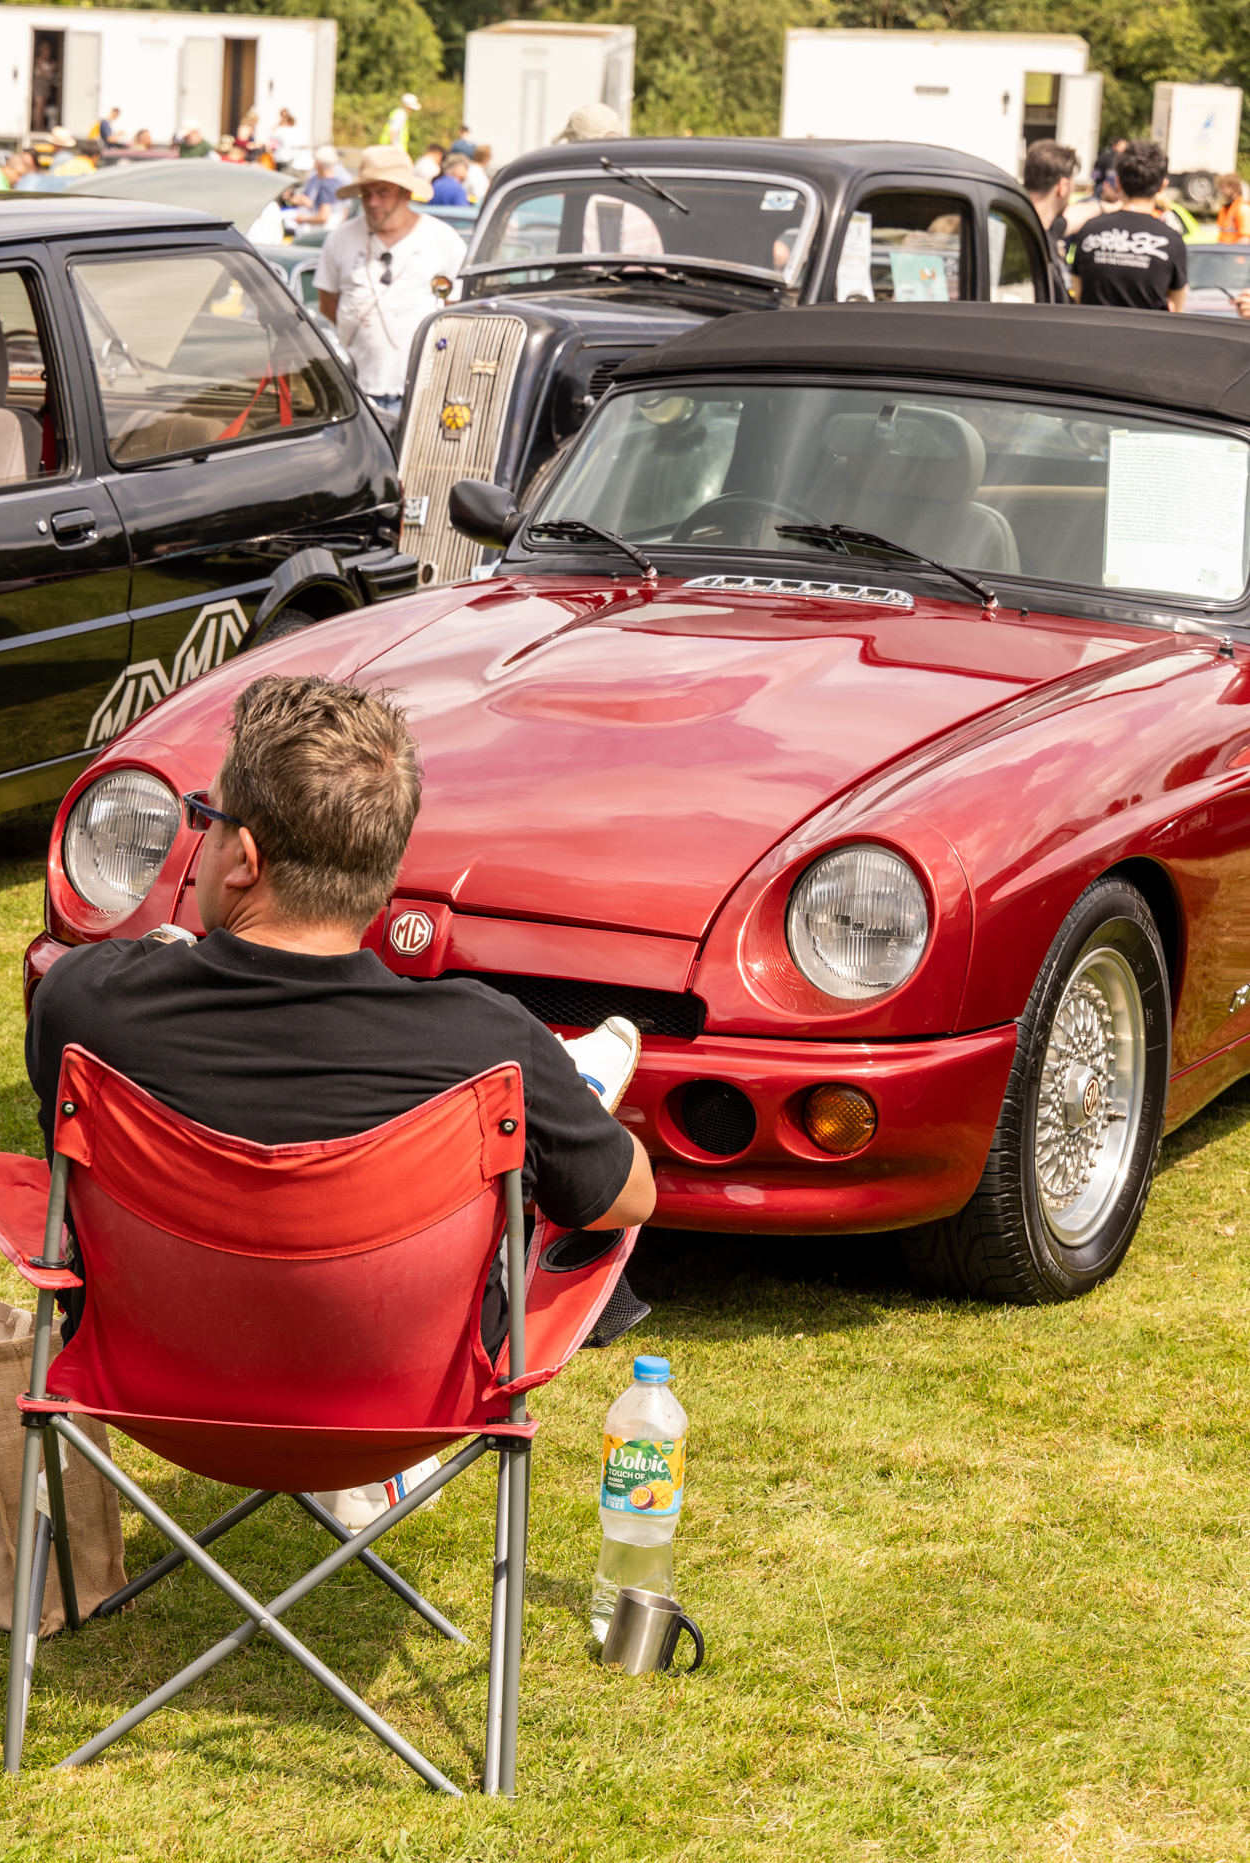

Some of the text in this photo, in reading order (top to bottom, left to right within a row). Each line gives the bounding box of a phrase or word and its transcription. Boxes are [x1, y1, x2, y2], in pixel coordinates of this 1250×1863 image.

[394, 915, 428, 950] MG
[609, 1447, 669, 1473] Volvic
[608, 1468, 646, 1480] TOUCH OF
[607, 1476, 624, 1484] MANGO
[607, 1481, 626, 1489] PASSION
[606, 1494, 625, 1503] SUGAR
[605, 1500, 625, 1510] FREE
